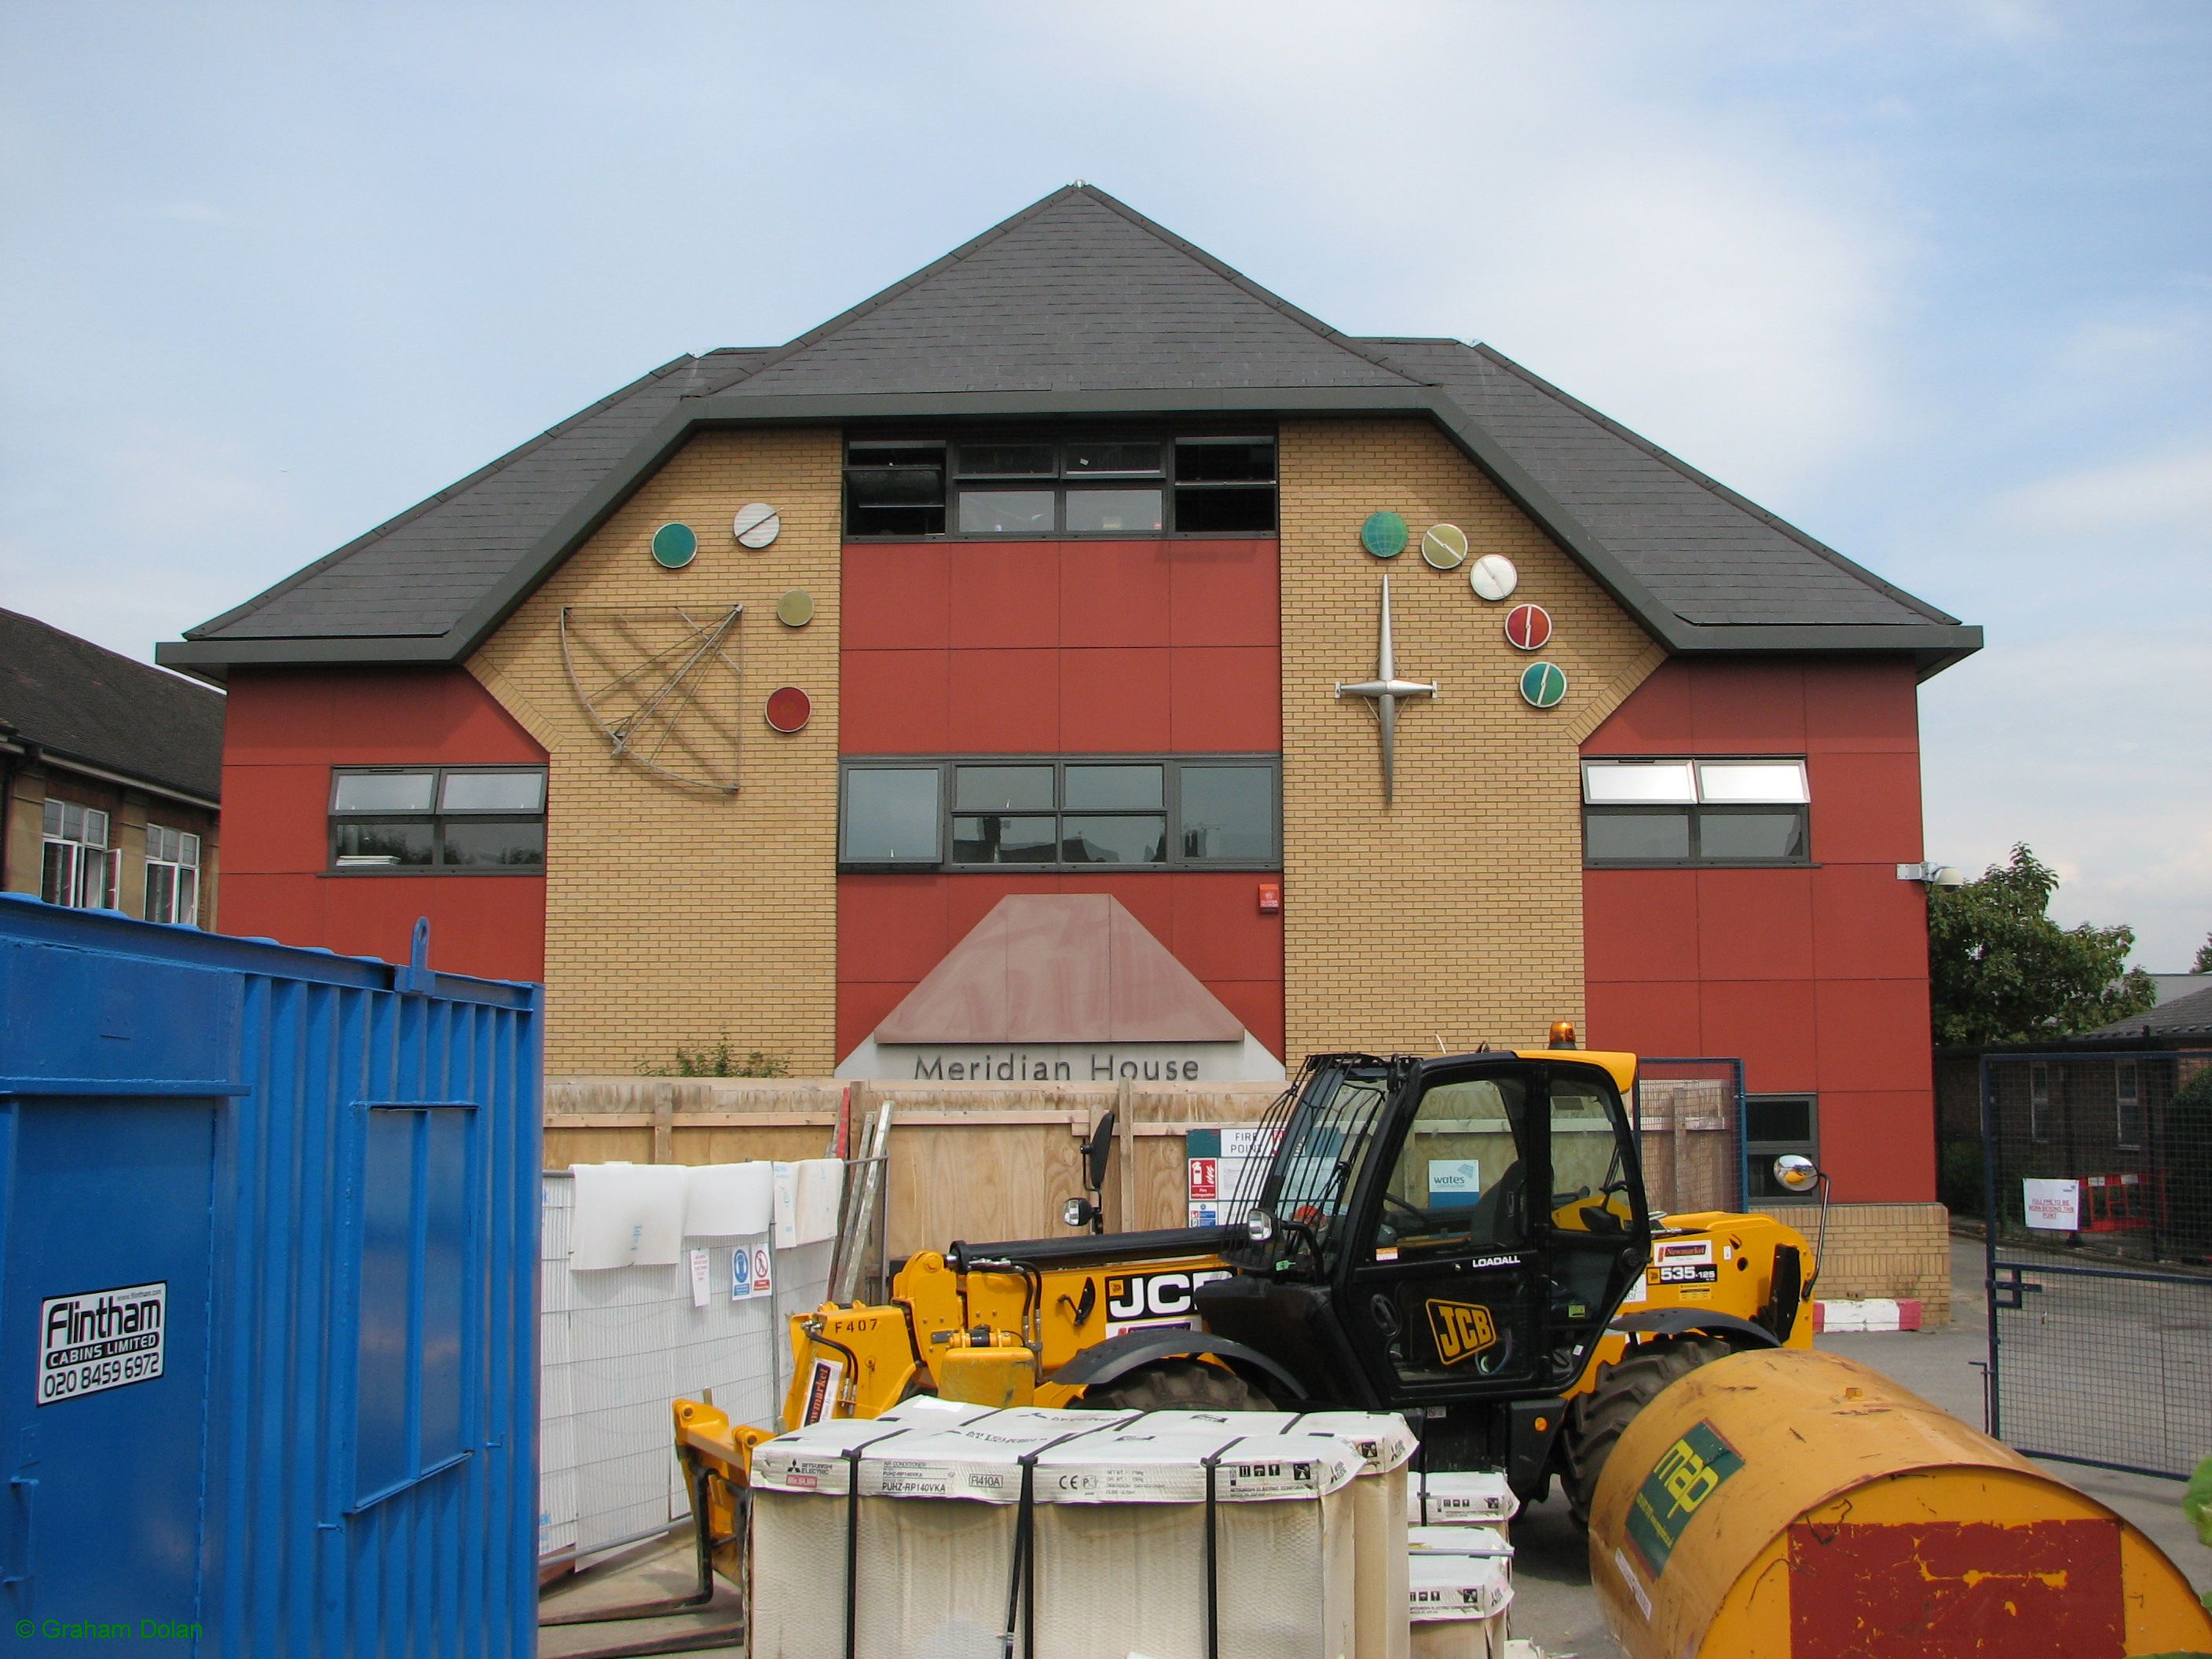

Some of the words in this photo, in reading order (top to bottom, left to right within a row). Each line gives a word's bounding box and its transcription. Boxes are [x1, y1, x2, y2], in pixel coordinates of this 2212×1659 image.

[914, 1053, 1071, 1081] Meridian
[1091, 1054, 1199, 1081] House
[1236, 1133, 1258, 1141] FIRE
[1230, 1144, 1262, 1154] POINT
[1472, 1255, 1521, 1268] LOADALL
[47, 1296, 161, 1349] Flintham
[1438, 1306, 1492, 1357] JCB
[50, 1345, 103, 1365] CABINS
[107, 1335, 156, 1355] LIMITED
[44, 1369, 77, 1397] 020
[81, 1361, 122, 1389] 8459
[124, 1352, 159, 1379] 6972
[882, 1481, 946, 1492] PUHZ-RP140VKA
[971, 1475, 1001, 1487] R410A
